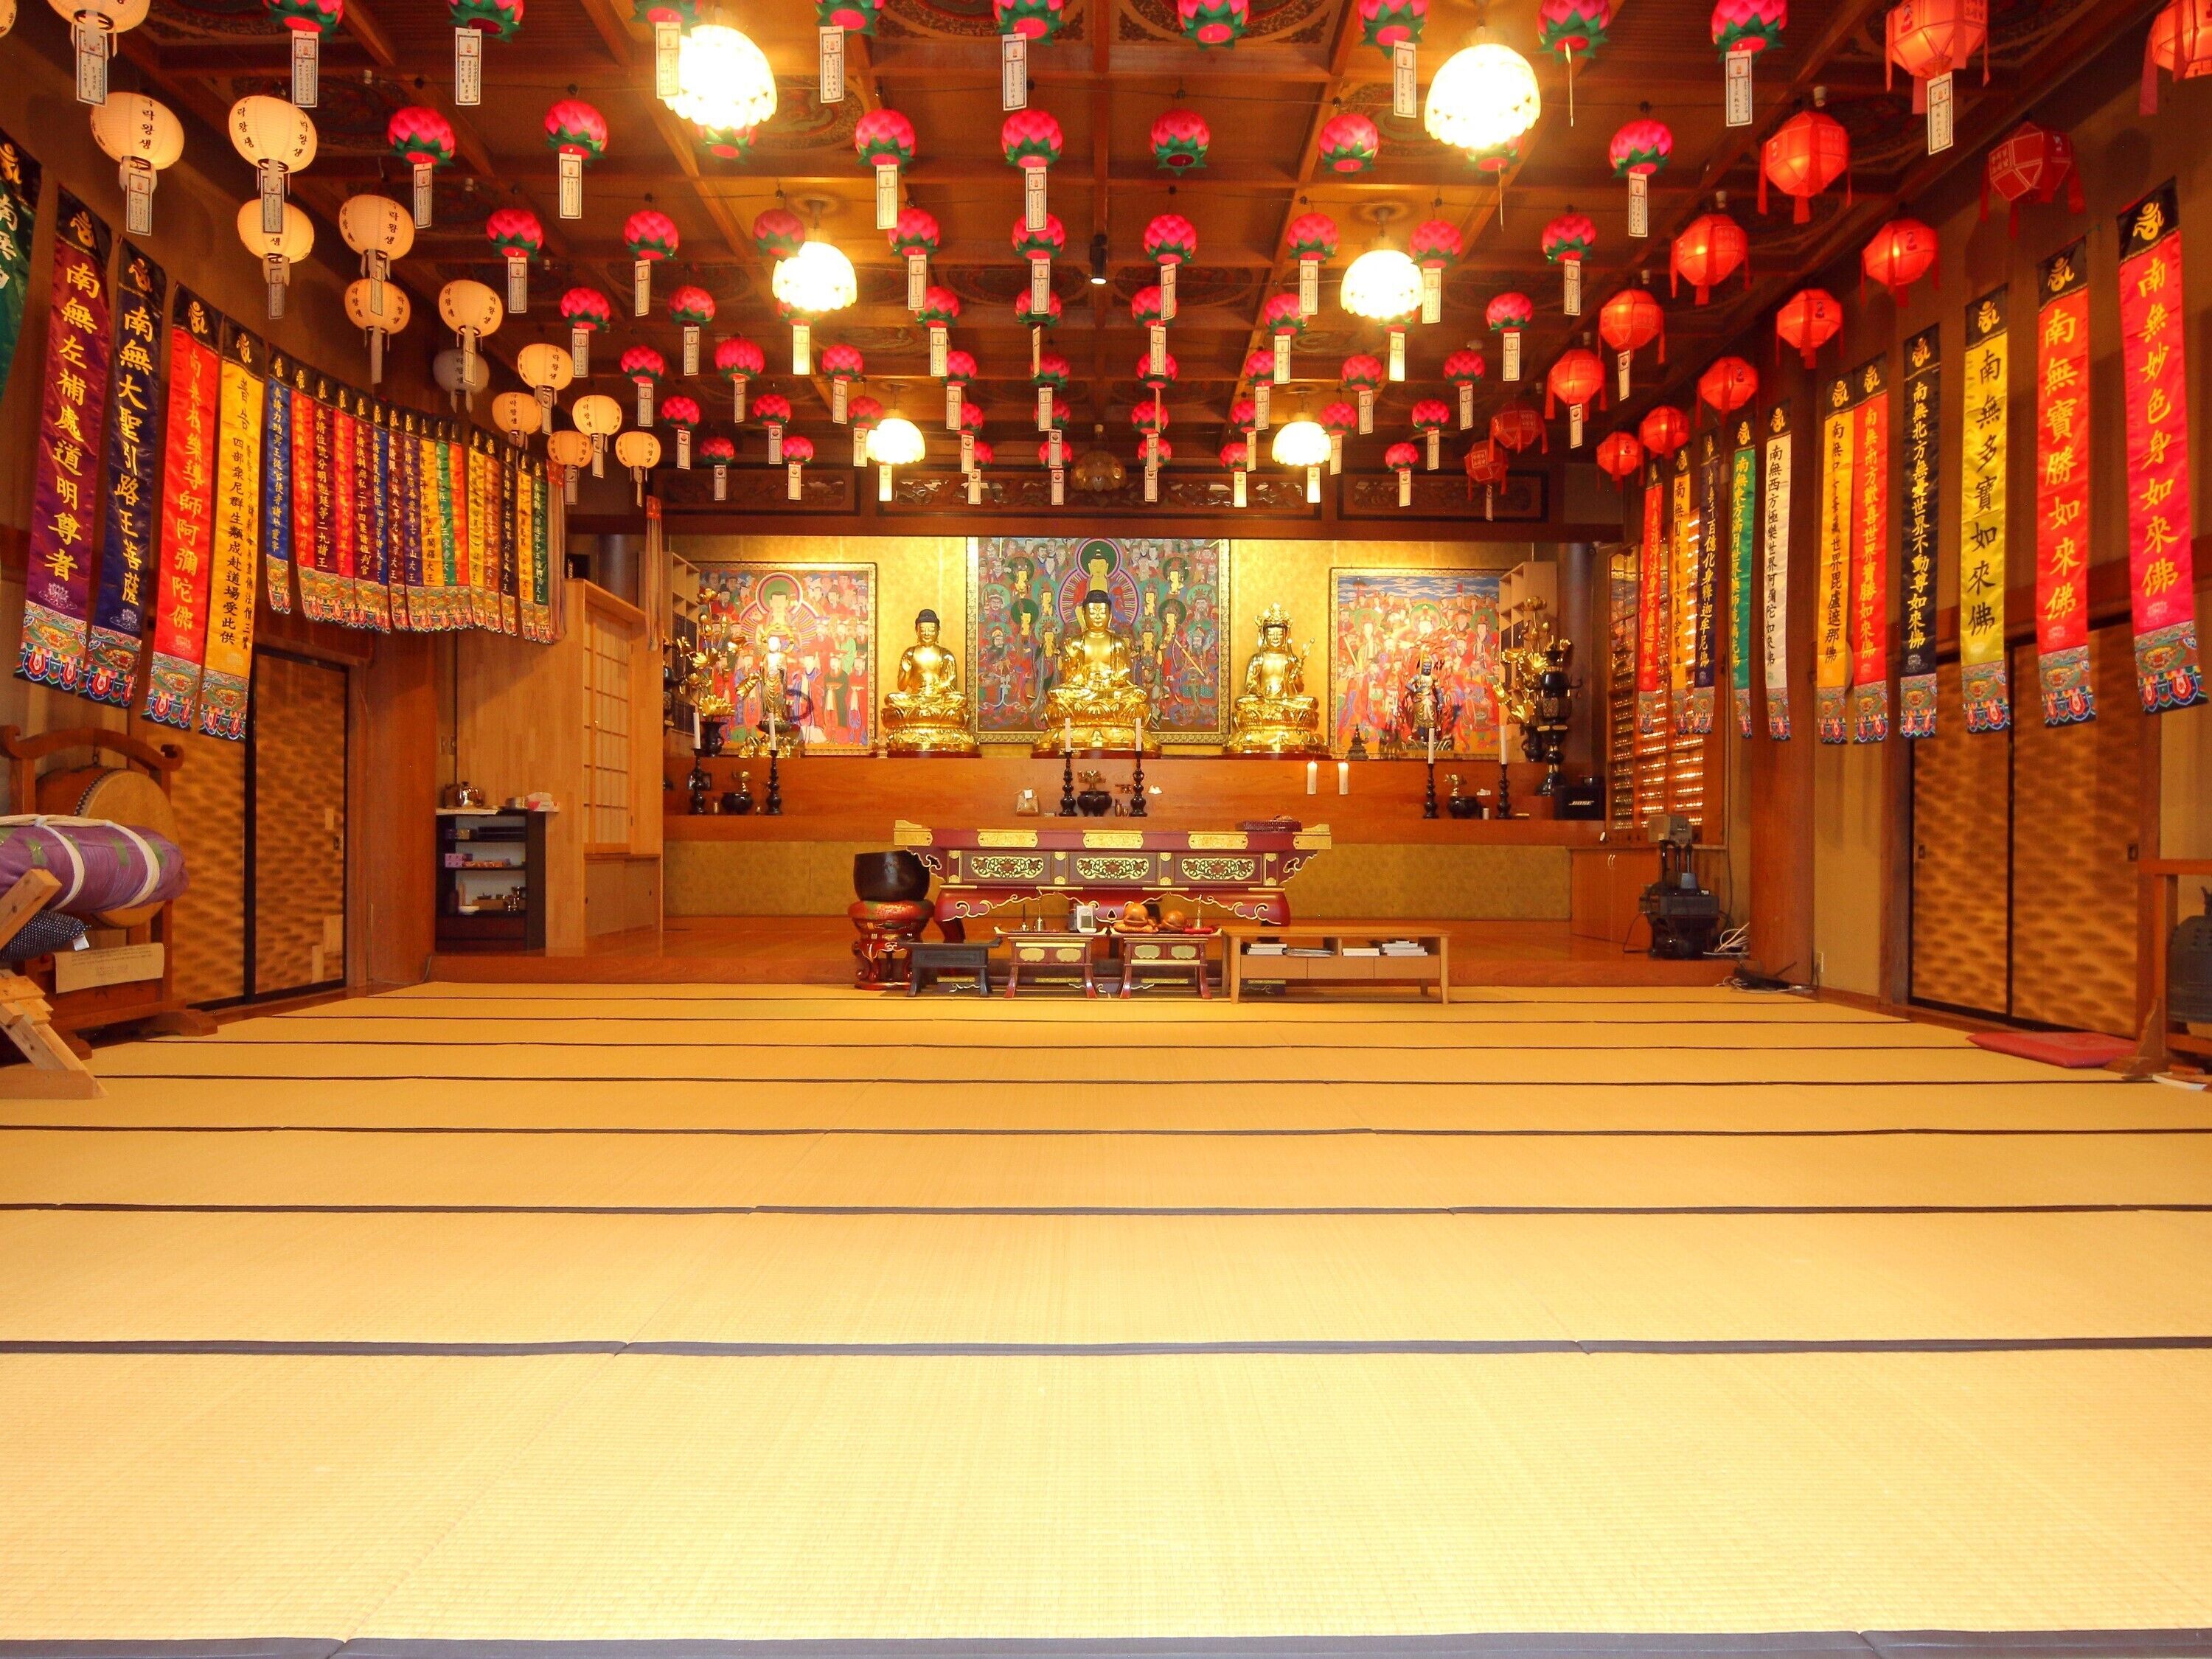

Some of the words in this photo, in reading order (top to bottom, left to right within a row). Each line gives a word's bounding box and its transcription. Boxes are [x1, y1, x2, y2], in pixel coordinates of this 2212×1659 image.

[139, 100, 155, 149] 락왕생
[386, 203, 399, 244] 락왕생
[44, 262, 100, 582] 南無左補處道明尊者
[114, 306, 153, 608] 南無大聖引路王菩薩
[1968, 349, 2002, 636] 南無多寶如來佛
[2044, 309, 2081, 621] 南無寶勝如來佛
[2138, 257, 2179, 598] 南無妙色身如來佛
